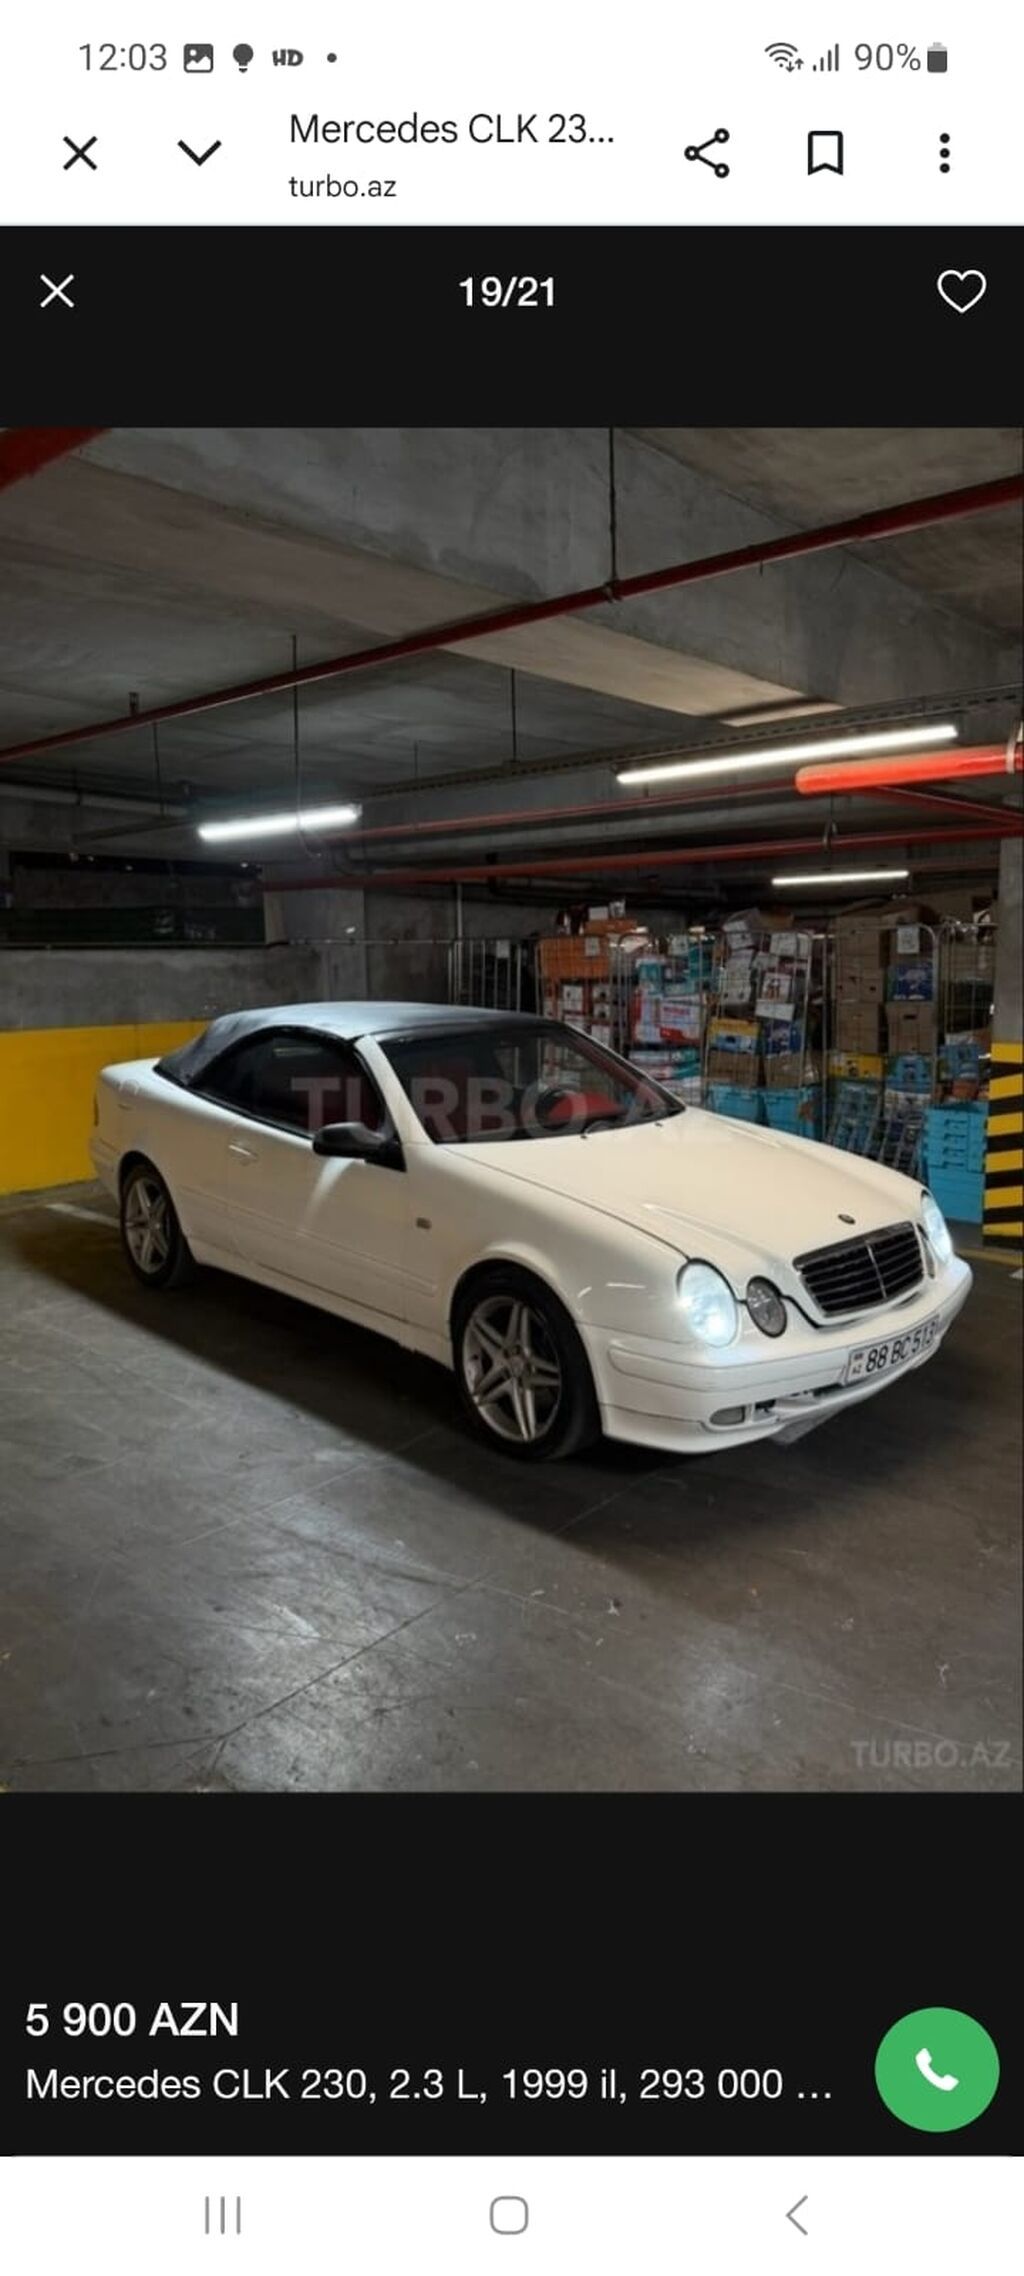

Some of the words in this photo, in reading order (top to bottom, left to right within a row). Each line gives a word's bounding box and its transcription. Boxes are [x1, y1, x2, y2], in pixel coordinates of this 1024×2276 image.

[79, 42, 168, 72] 12:03
[271, 48, 304, 67] HD
[854, 42, 922, 71] 90%
[290, 111, 459, 144] Mercedes
[468, 112, 539, 144] CLK
[287, 173, 398, 198] turbo.az
[458, 275, 554, 308] 19/21
[25, 2002, 50, 2037] 5
[62, 2002, 137, 2037] 900
[148, 2002, 239, 2037] AZN
[26, 2068, 202, 2100] Mercedes
[212, 2068, 291, 2100] CLK
[300, 2068, 377, 2105] 230,
[389, 2068, 444, 2099] 2.3
[457, 2068, 487, 2105] L,
[502, 2068, 589, 2099] 1999
[601, 2068, 627, 2105] il,
[639, 2068, 706, 2099] 293
[717, 2068, 783, 2099] 000
